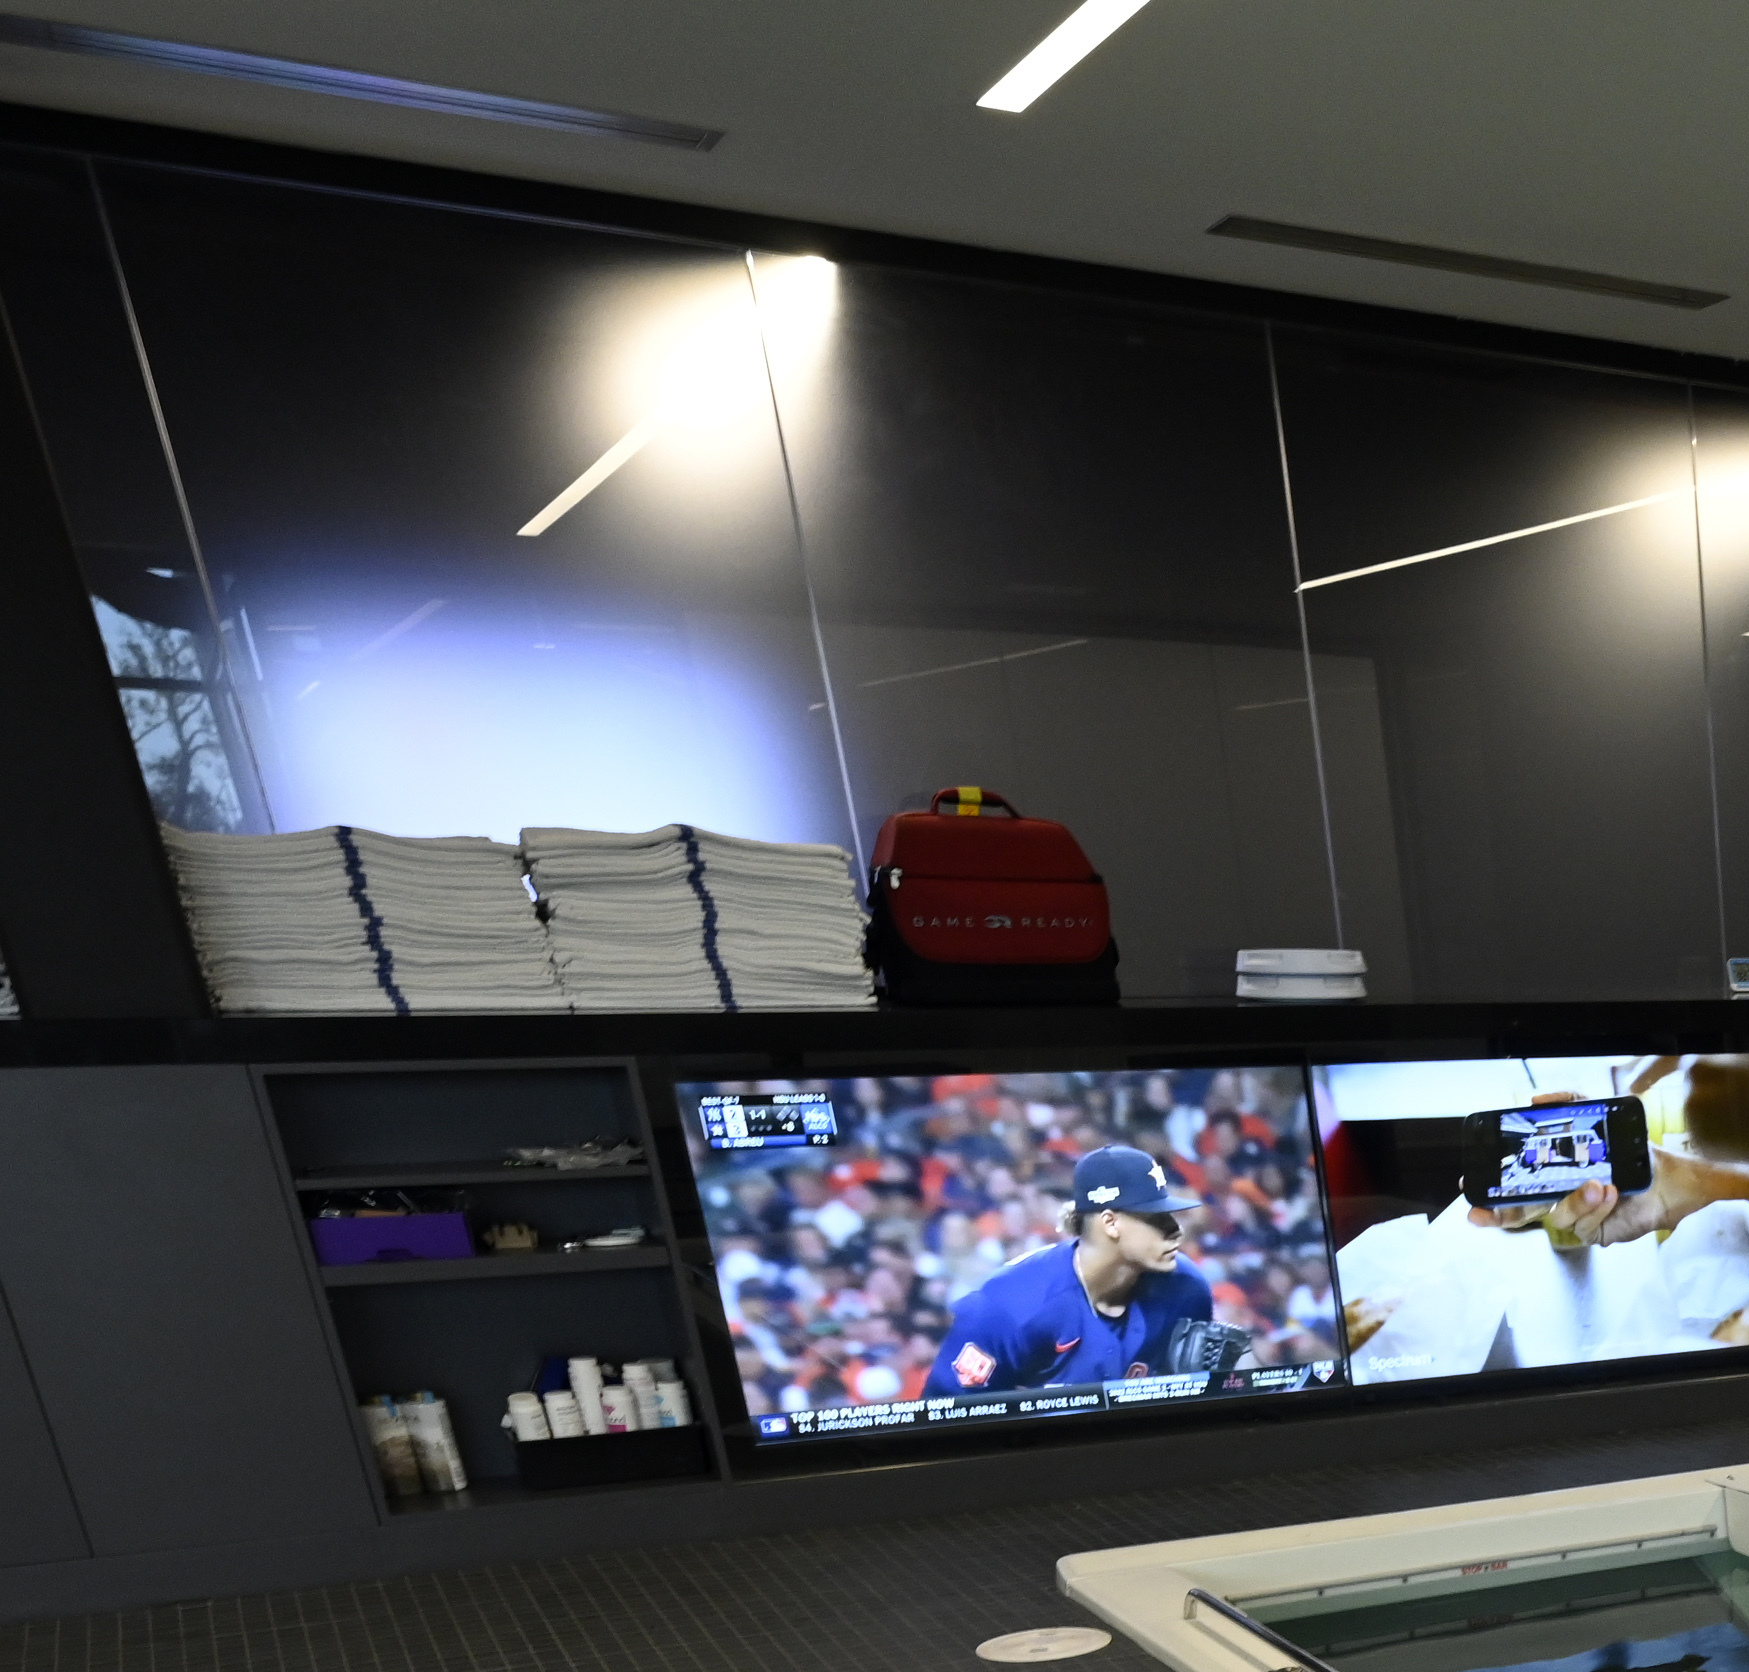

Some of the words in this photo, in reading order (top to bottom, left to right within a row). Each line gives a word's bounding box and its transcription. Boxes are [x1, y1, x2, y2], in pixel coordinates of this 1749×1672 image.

[912, 916, 976, 928] GAME
[1021, 916, 1089, 928] READY
[1368, 1353, 1432, 1373] Spectrum
[790, 1411, 815, 1425] TOP
[816, 1408, 839, 1422] 100
[839, 1403, 891, 1419] PLAYERS
[891, 1400, 926, 1415] RIGHT
[926, 1397, 955, 1411] NOW
[817, 1418, 873, 1432] JURICKSON
[874, 1412, 915, 1426] PROFAR
[945, 1407, 968, 1420] LUIS
[969, 1403, 1008, 1417] ARRAEZ
[1036, 1397, 1068, 1411] ROYCE
[1069, 1394, 1100, 1407] LEWIS
